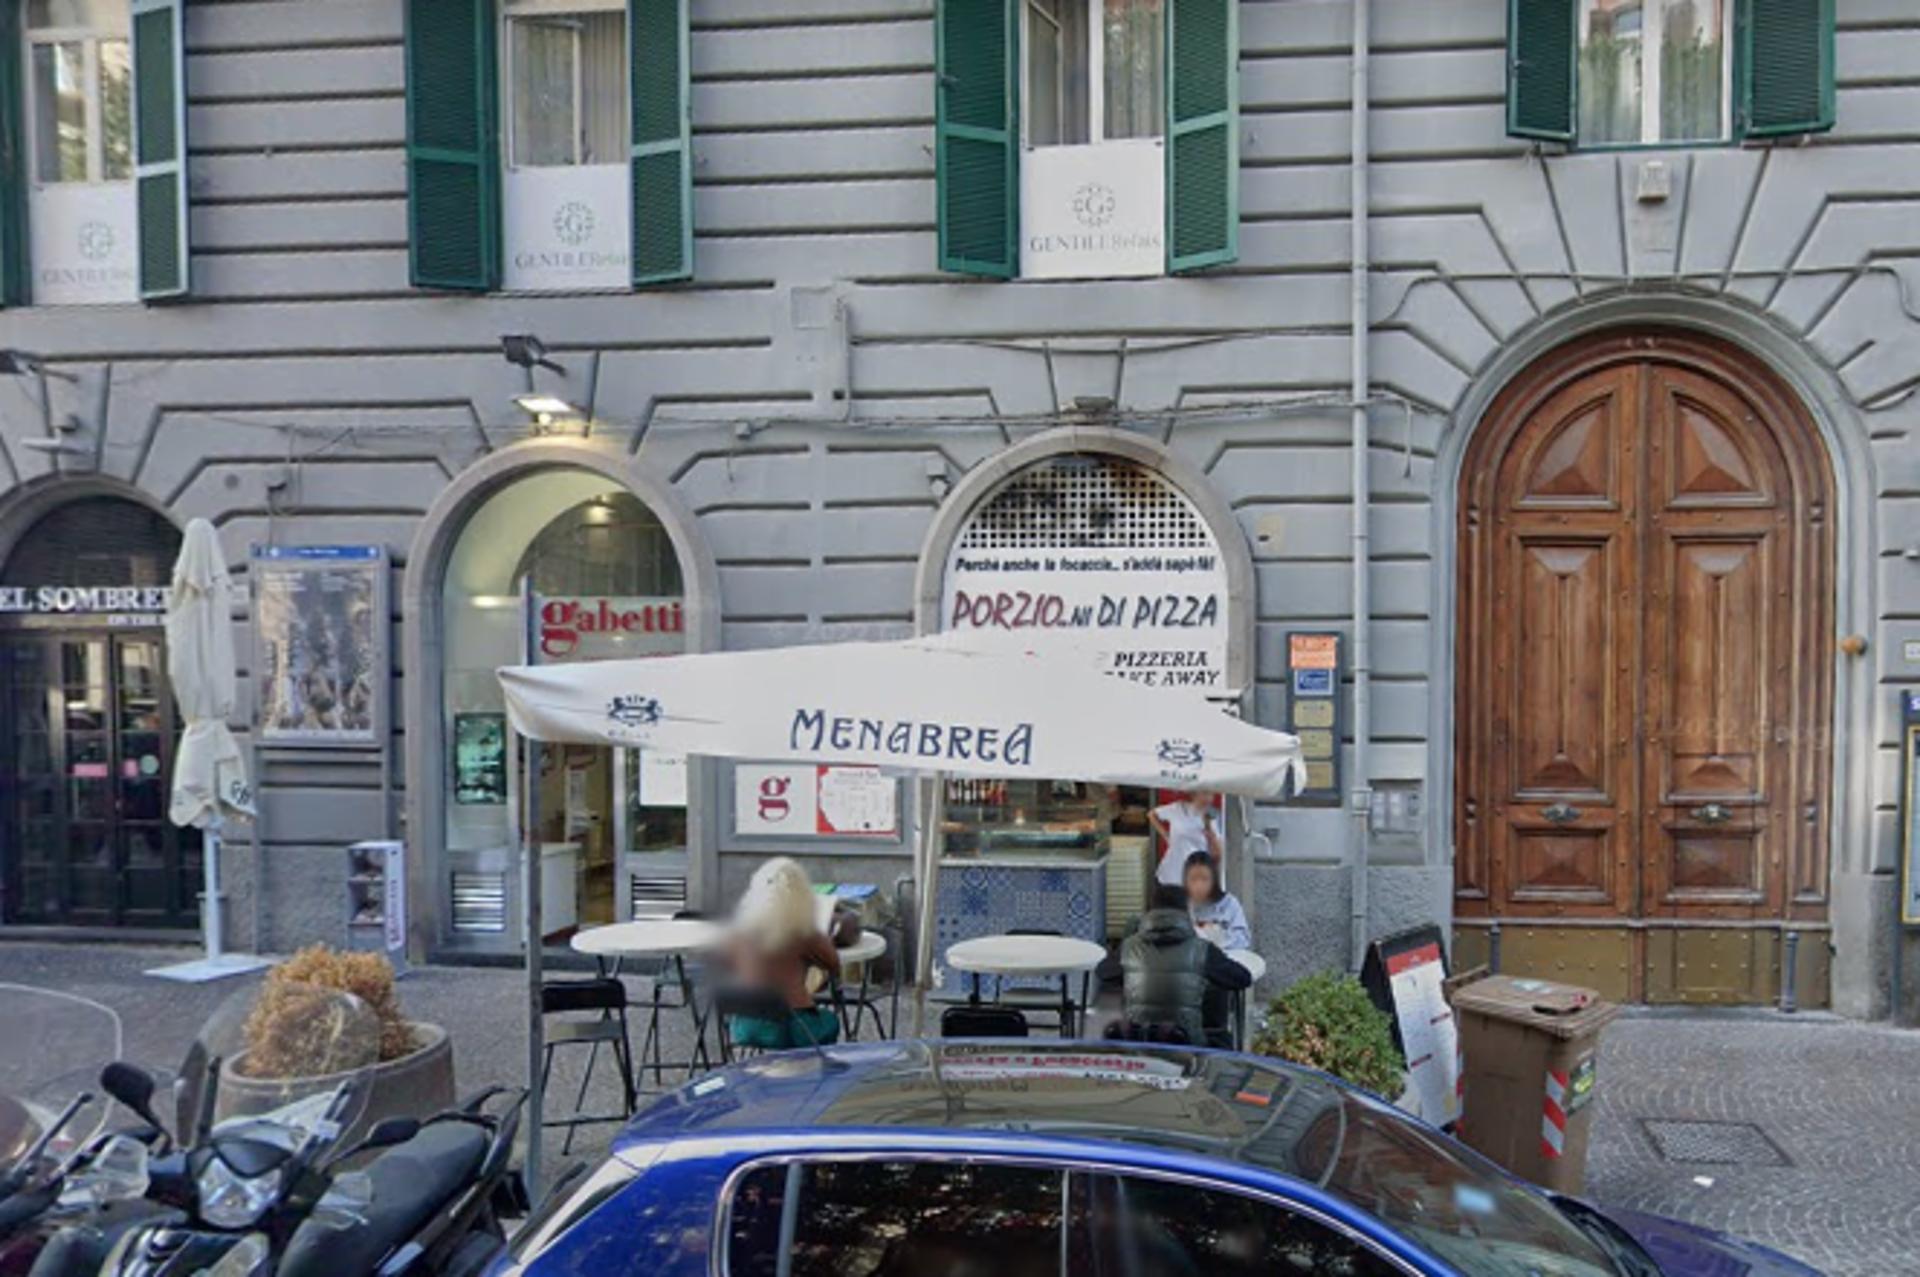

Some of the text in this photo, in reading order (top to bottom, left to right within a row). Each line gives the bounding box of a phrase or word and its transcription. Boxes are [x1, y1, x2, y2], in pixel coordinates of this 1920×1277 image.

[1002, 557, 1040, 571] anche
[1045, 557, 1056, 571] la
[0, 587, 33, 610] EL
[1097, 595, 1127, 627] DI
[1132, 594, 1217, 628] PIZZA
[540, 599, 686, 656] gabetti
[1114, 651, 1208, 667] PIZZERIA
[1161, 670, 1220, 687] AWAY
[758, 776, 791, 822] g
